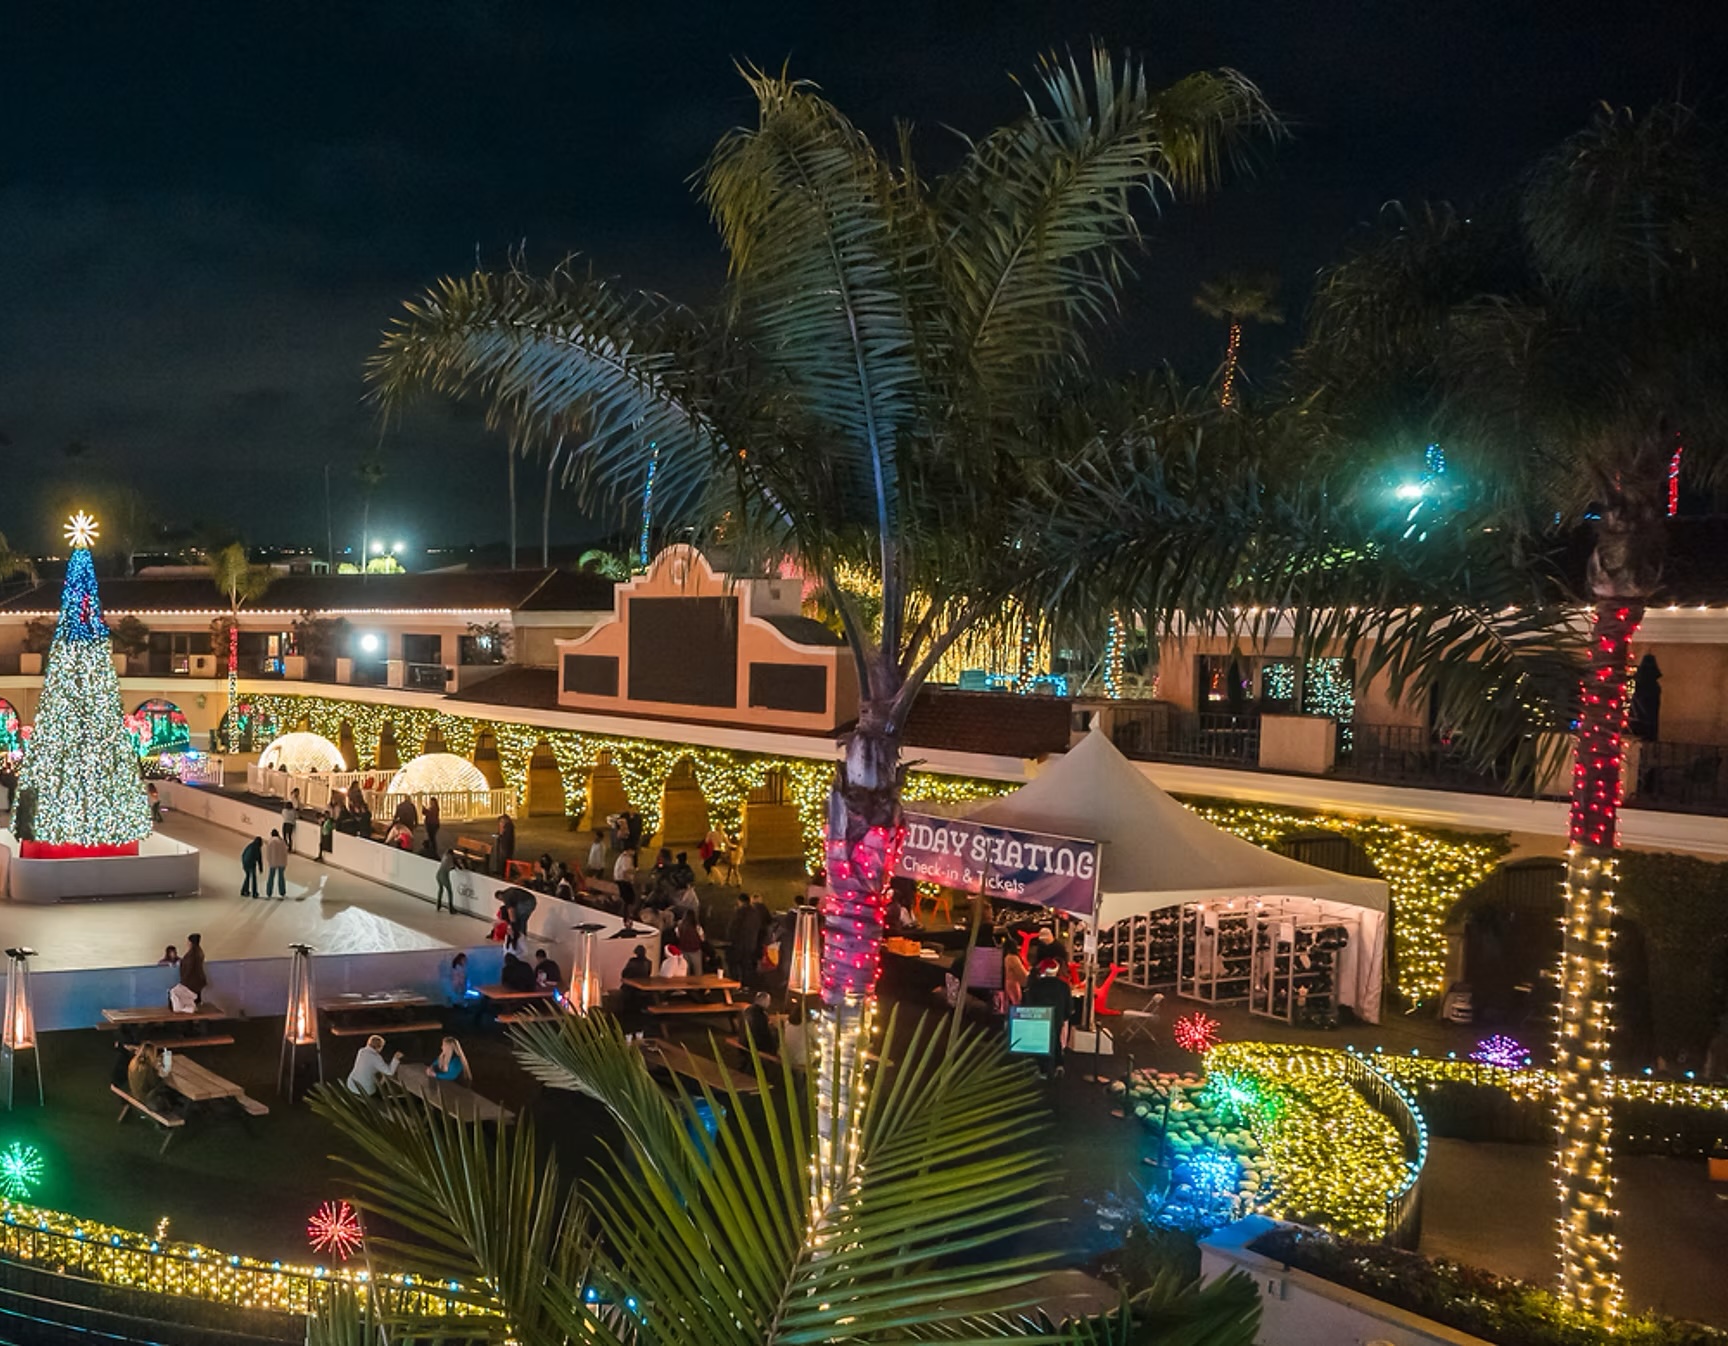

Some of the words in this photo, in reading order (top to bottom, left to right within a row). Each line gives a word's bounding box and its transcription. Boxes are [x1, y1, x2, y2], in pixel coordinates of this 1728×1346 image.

[902, 855, 958, 880] Check-in
[962, 867, 973, 884] &
[976, 870, 1025, 895] Tickets
[903, 823, 969, 857] IDAY
[970, 834, 1094, 880] SKATING
